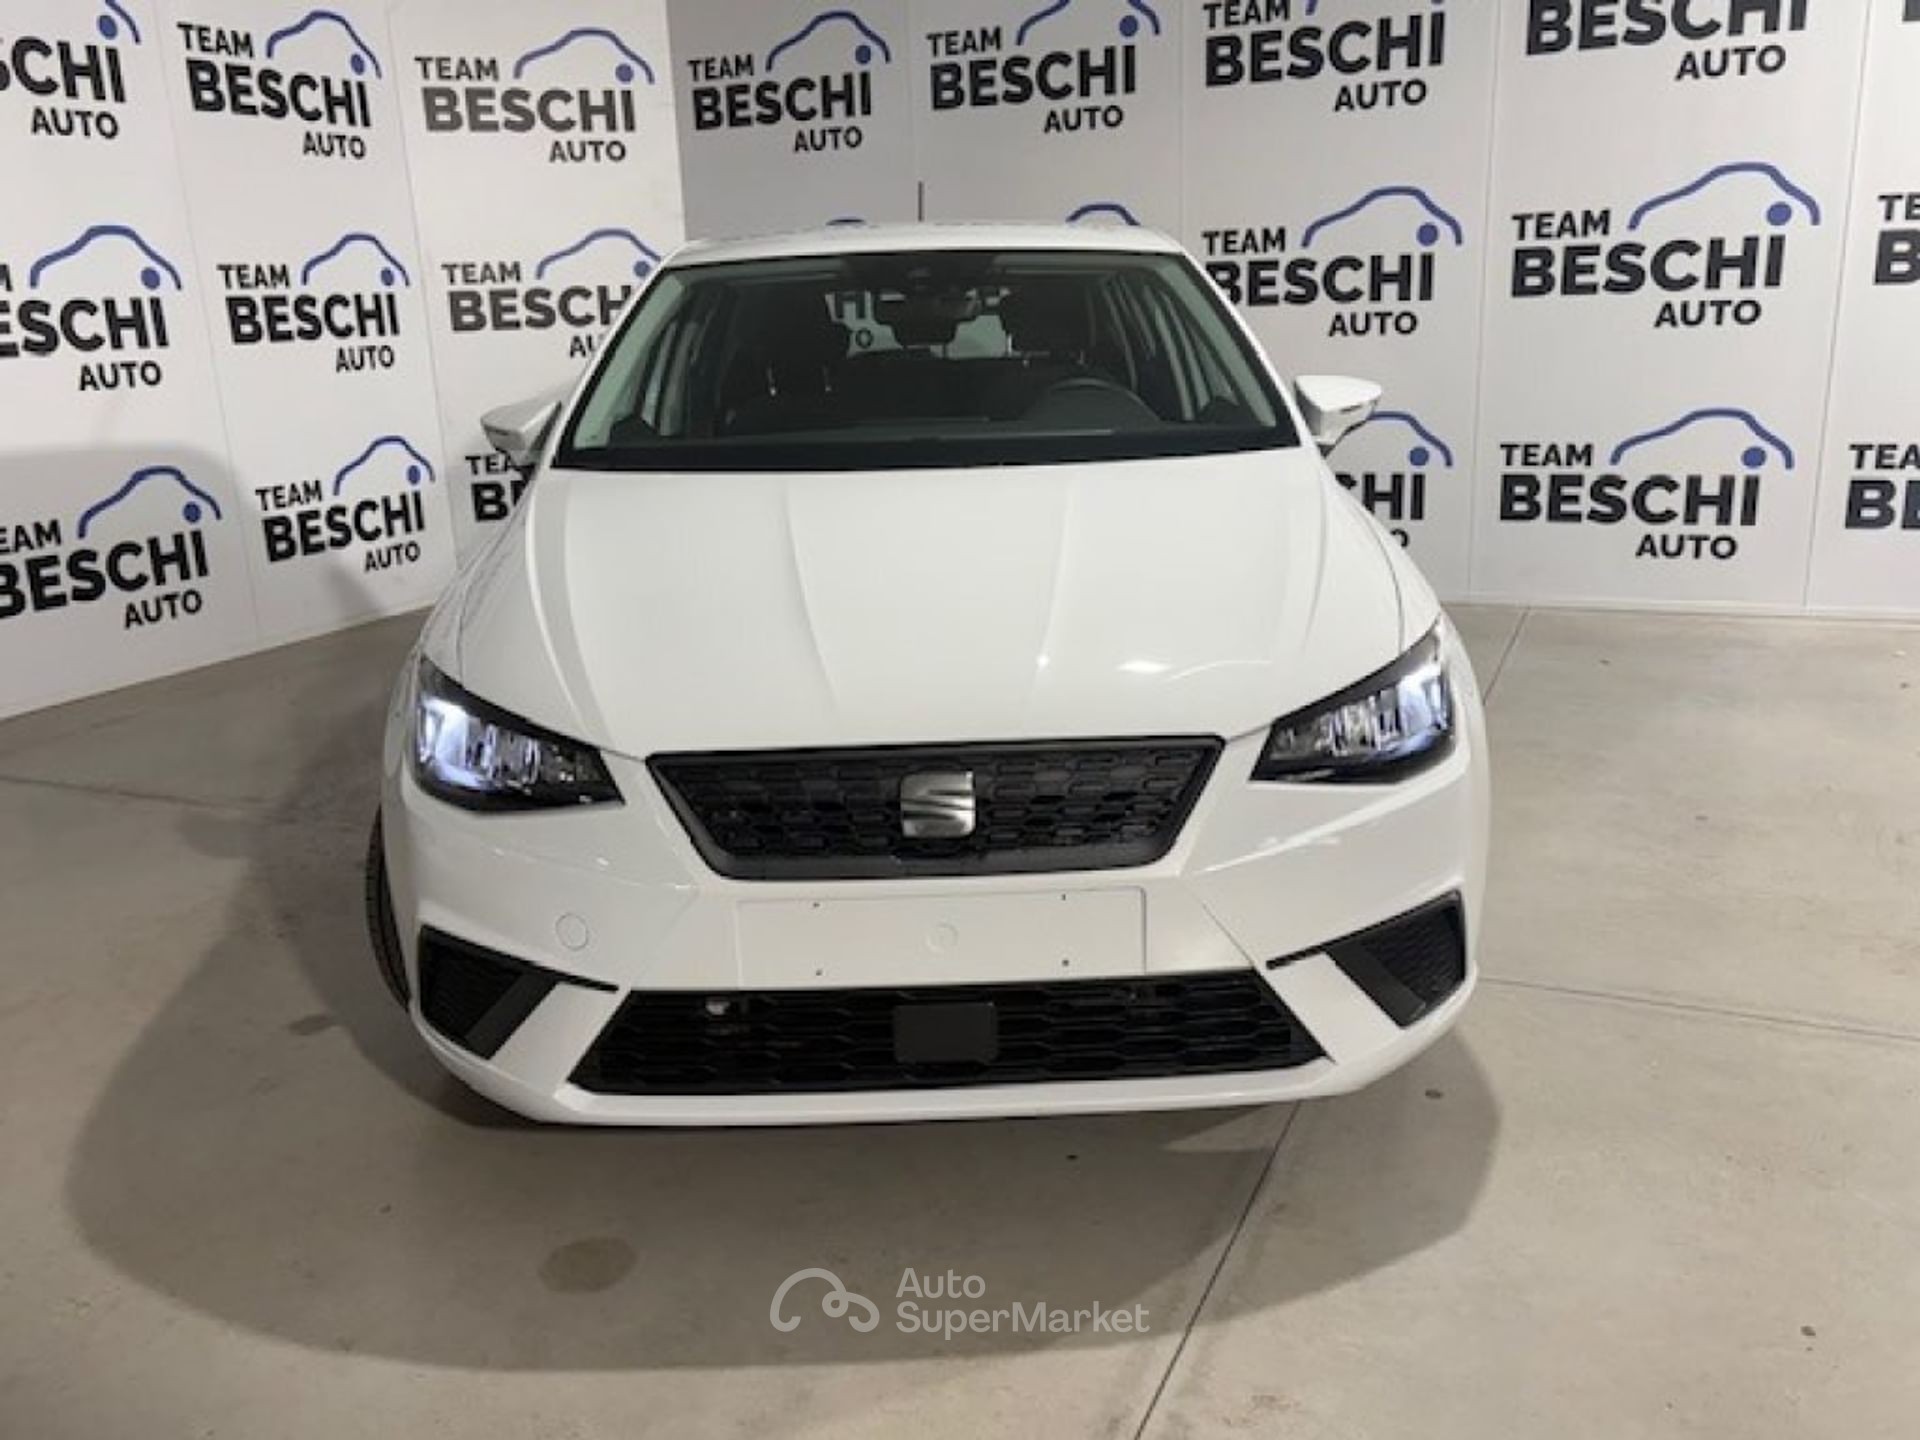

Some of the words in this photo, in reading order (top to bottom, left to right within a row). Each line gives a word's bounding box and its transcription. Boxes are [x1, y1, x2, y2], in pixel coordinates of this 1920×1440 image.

[1202, 0, 1291, 30] TEAM
[176, 22, 254, 59] TEAM
[926, 26, 1002, 57] TEAM
[1205, 9, 1445, 89] BESCHI
[414, 56, 499, 81] TEAM
[687, 53, 754, 82] TEAM
[930, 43, 1136, 112] BESCHI
[1675, 44, 1786, 81] AUTO
[185, 54, 371, 128] BESCHI
[692, 70, 872, 132] BESCHI
[1334, 78, 1427, 112] AUTO
[31, 107, 119, 140] AUTO
[421, 86, 636, 133] BESCHI
[1043, 104, 1124, 134] AUTO
[303, 131, 366, 160] AUTO
[549, 140, 627, 163] AUTO
[794, 125, 863, 153] AUTO
[1511, 209, 1611, 241] TEAM
[1202, 227, 1286, 256] TEAM
[217, 263, 290, 289] TEAM
[440, 261, 522, 286] TEAM
[1511, 233, 1786, 298] BESCHI
[225, 293, 400, 345] BESCHI
[1328, 311, 1418, 337] AUTO
[1654, 299, 1762, 328] AUTO
[335, 344, 395, 373] AUTO
[79, 360, 162, 392] AUTO
[1499, 443, 1593, 467] TEAM
[254, 479, 323, 513] TEAM
[1499, 473, 1760, 526] BESCHI
[259, 487, 425, 565] BESCHI
[361, 538, 421, 572] AUTO
[1635, 533, 1737, 560] AUTO
[122, 586, 203, 629] AUTO
